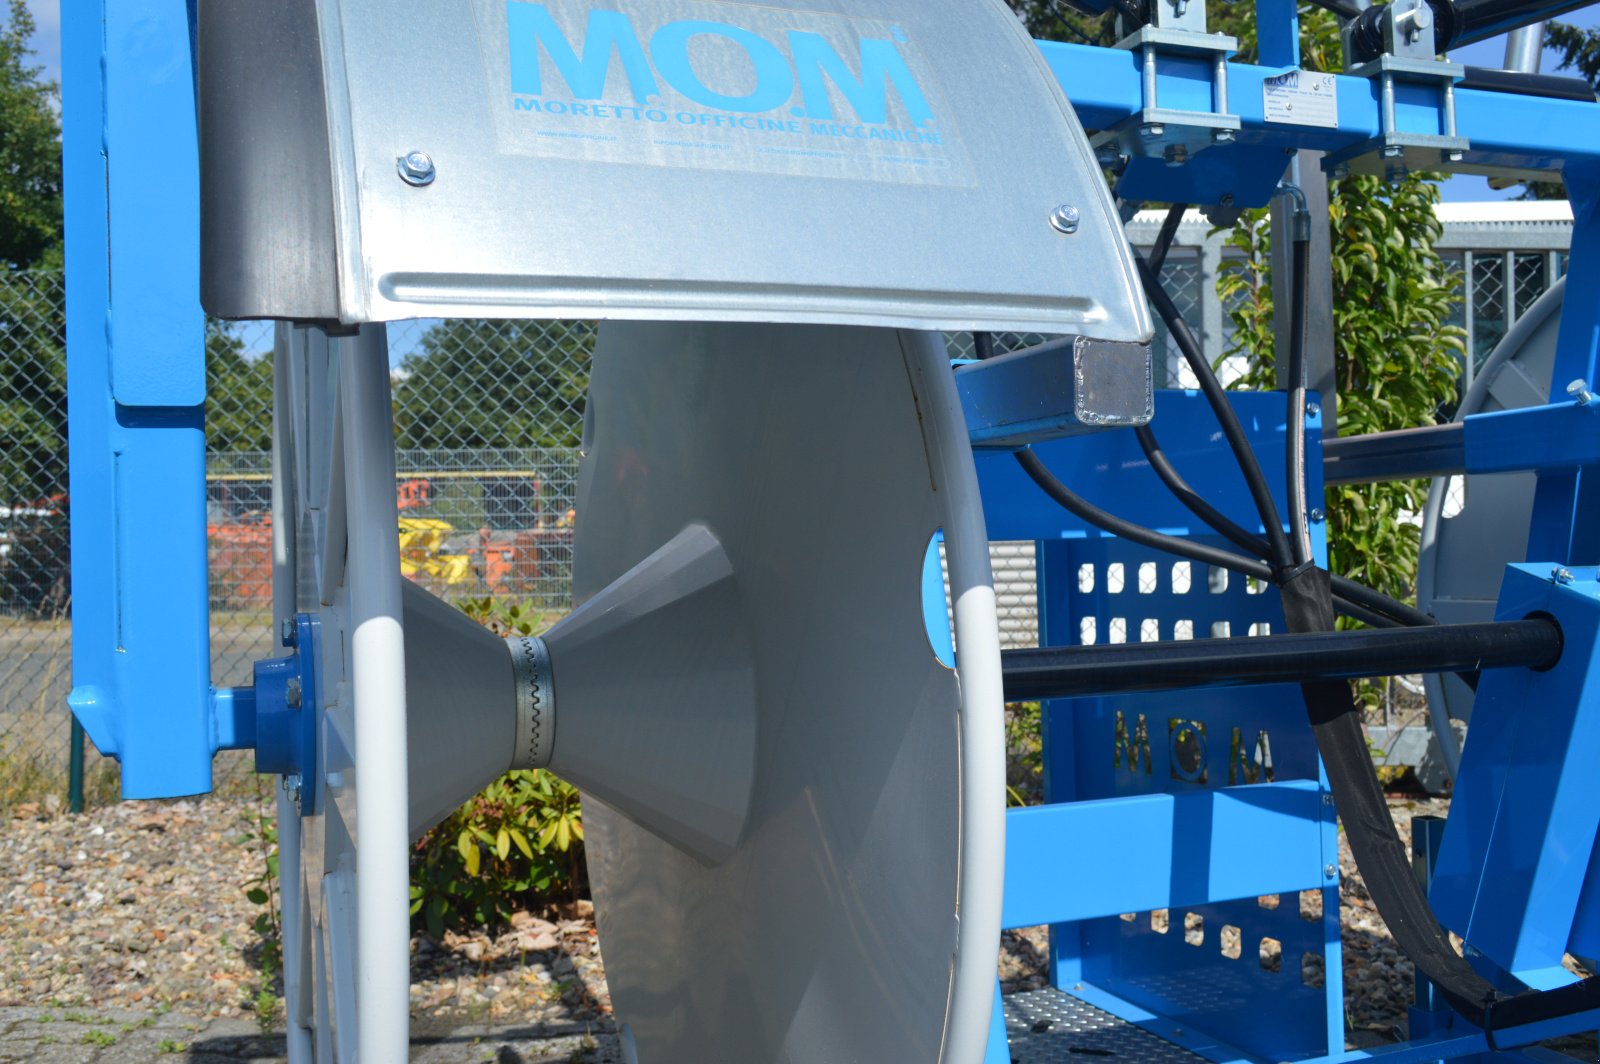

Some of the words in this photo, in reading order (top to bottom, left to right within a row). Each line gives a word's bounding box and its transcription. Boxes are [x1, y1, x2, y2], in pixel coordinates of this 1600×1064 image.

[514, 97, 667, 123] MORETTO
[675, 111, 801, 134] OFFICINE
[810, 123, 944, 145] MECCANICHE
[1114, 710, 1274, 785] MOM
